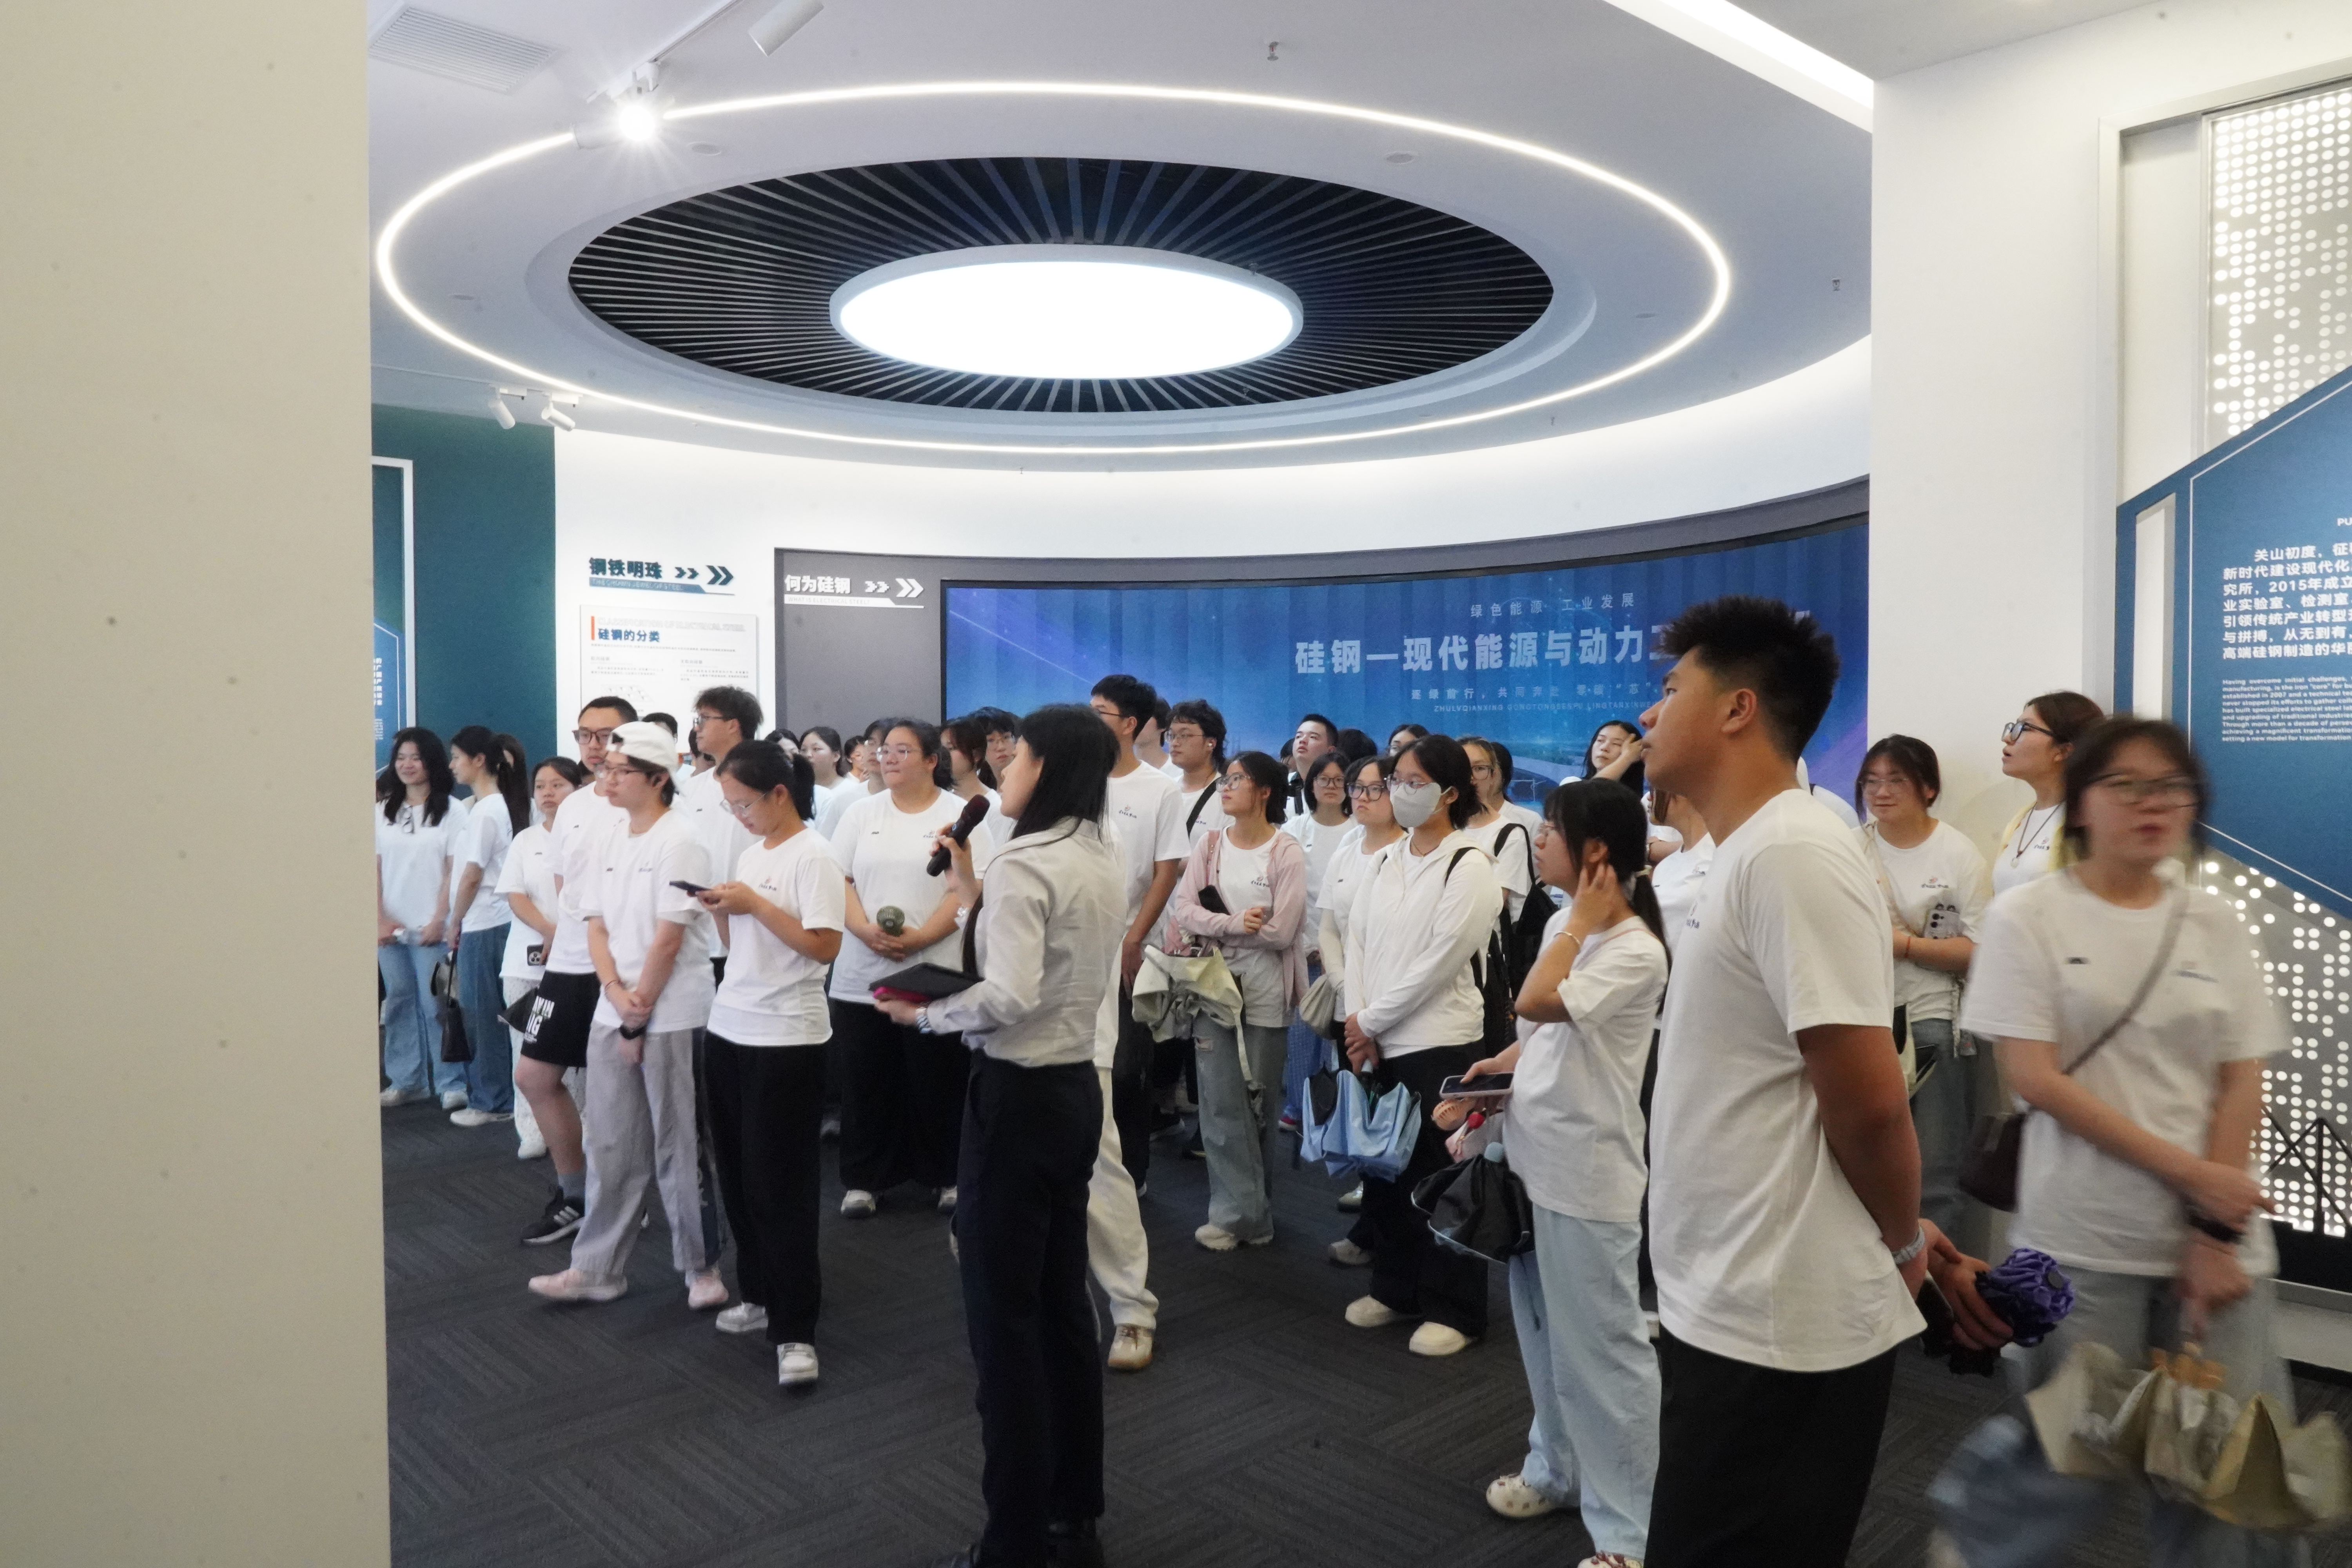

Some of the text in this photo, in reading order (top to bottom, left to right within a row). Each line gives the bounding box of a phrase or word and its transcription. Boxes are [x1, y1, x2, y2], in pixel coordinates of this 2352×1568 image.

[2254, 543, 2352, 562] 关山初度，征
[2223, 559, 2352, 580] 新时代建设现代化
[785, 574, 851, 594] 何为硅钢
[1470, 593, 1634, 618] 绿色能源 工业发展
[2223, 608, 2352, 628] 引领传统产业转型
[598, 628, 660, 642] 硅钢的分类
